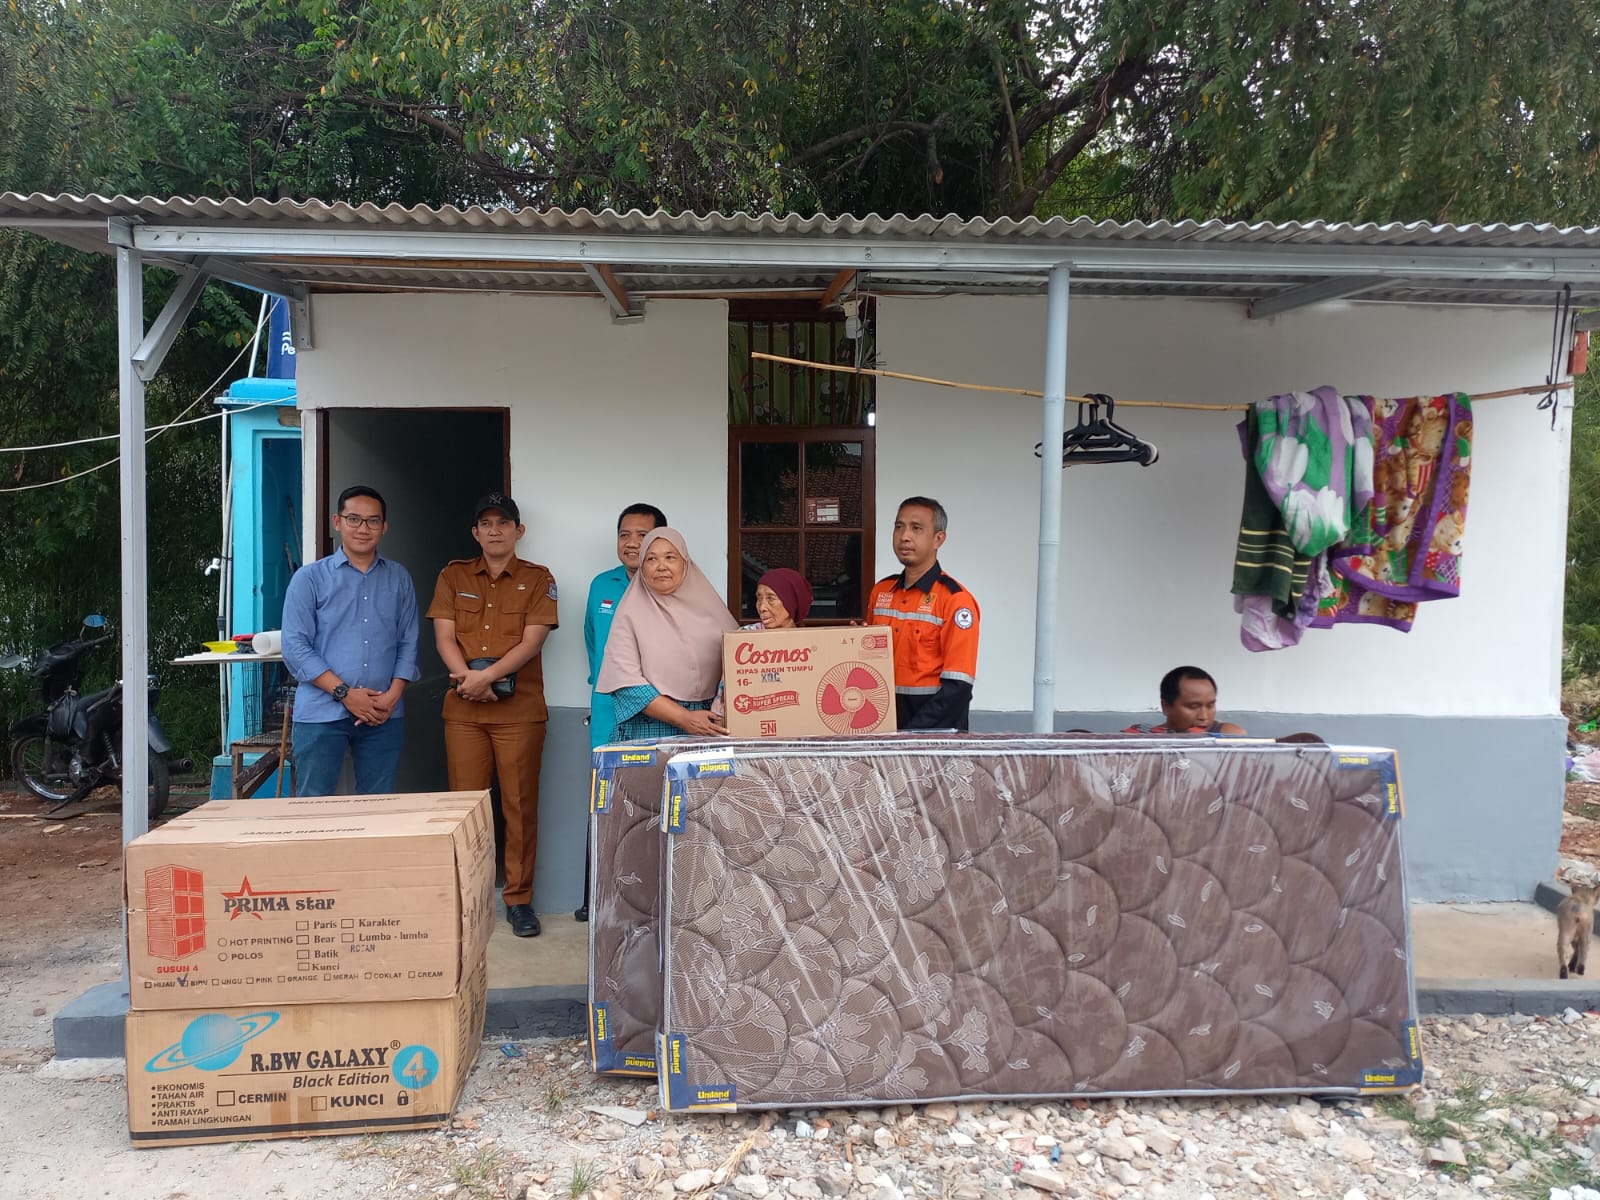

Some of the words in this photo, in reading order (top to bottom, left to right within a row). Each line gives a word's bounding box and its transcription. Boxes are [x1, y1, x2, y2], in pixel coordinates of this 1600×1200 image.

[735, 642, 811, 665] Cosmos
[737, 678, 753, 687] 16-
[760, 722, 777, 734] SNI
[223, 897, 290, 913] PRIMA
[295, 896, 336, 911] star
[313, 920, 338, 930] Paris
[358, 918, 401, 928] Karakter
[229, 938, 249, 947] HOT
[250, 936, 294, 946] PRINTING
[313, 934, 336, 944] Bear
[359, 932, 392, 942] Lumba
[400, 931, 429, 940] lumba
[231, 952, 264, 961] POLOS
[314, 949, 339, 959] Batik
[156, 966, 190, 974] SUSUN
[311, 962, 341, 972] Kunci
[287, 974, 318, 982] ORANGE
[417, 970, 443, 978] CREAM
[250, 1052, 302, 1072] R.BW
[306, 1047, 389, 1069] GALAXY
[672, 1040, 681, 1074] Uniland
[401, 1051, 428, 1082] 4
[293, 1074, 333, 1089] Black
[338, 1072, 390, 1086] Edition
[157, 1083, 205, 1092] EKONOMIS
[157, 1092, 187, 1100] TAHAN
[238, 1093, 287, 1104] CERMIN
[698, 1090, 730, 1099] Uniland
[330, 1094, 384, 1108] KUNCI
[157, 1109, 178, 1117] ANTI
[180, 1108, 209, 1117] RAYAP
[157, 1118, 190, 1126] RAMAH
[192, 1115, 252, 1125] LINGKUNGAN
